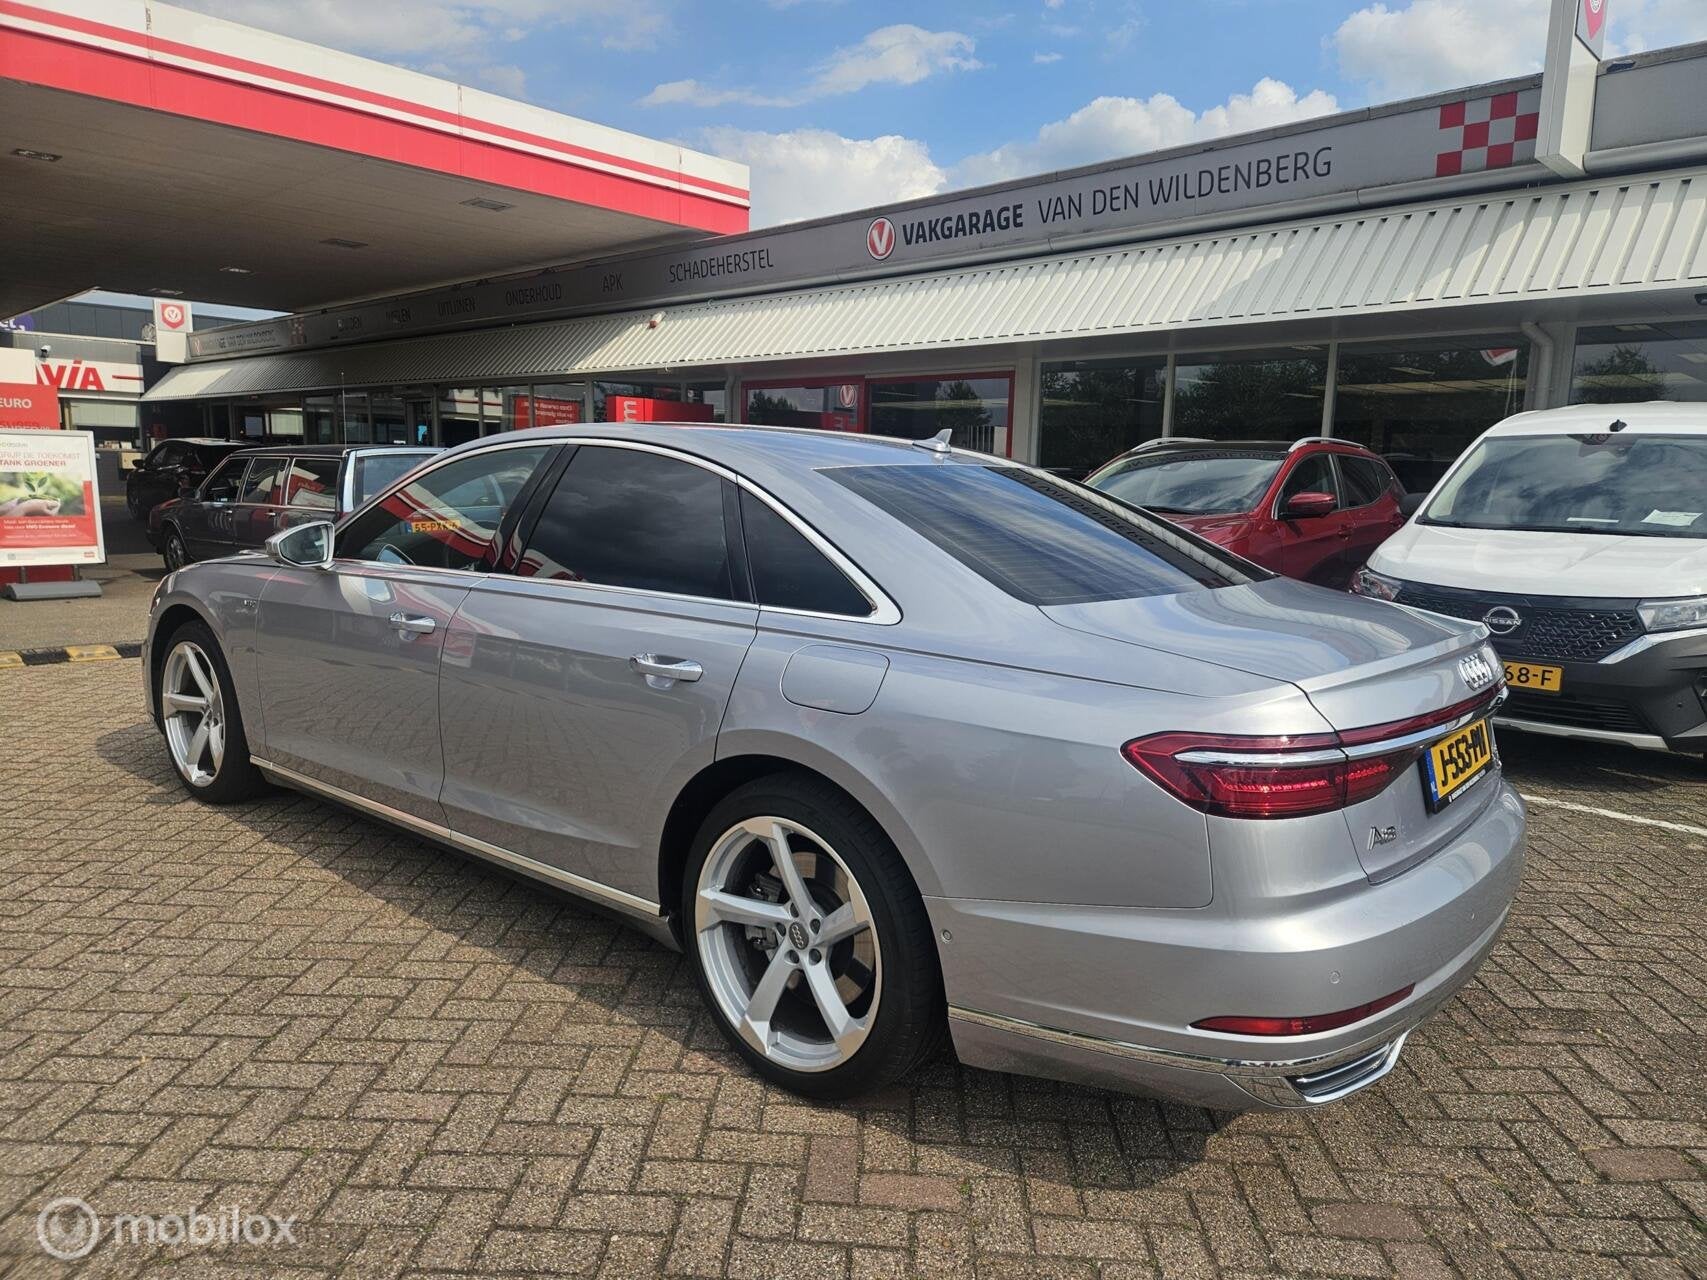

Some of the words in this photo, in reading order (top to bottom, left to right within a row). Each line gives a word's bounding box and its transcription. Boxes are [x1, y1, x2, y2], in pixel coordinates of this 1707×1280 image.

[902, 203, 1023, 246] VAKGARAGE
[1037, 192, 1082, 224] VAN
[1092, 183, 1140, 216] DEN
[1149, 146, 1333, 206] WILDENBERG
[668, 248, 774, 284] SCHADEHERSTEL
[504, 283, 563, 307] ONDERHOUD
[601, 272, 624, 294] APK
[41, 359, 105, 391] VIA
[0, 459, 22, 467] TANK
[25, 459, 66, 467] GROENER
[1482, 616, 1522, 626] NISSAN
